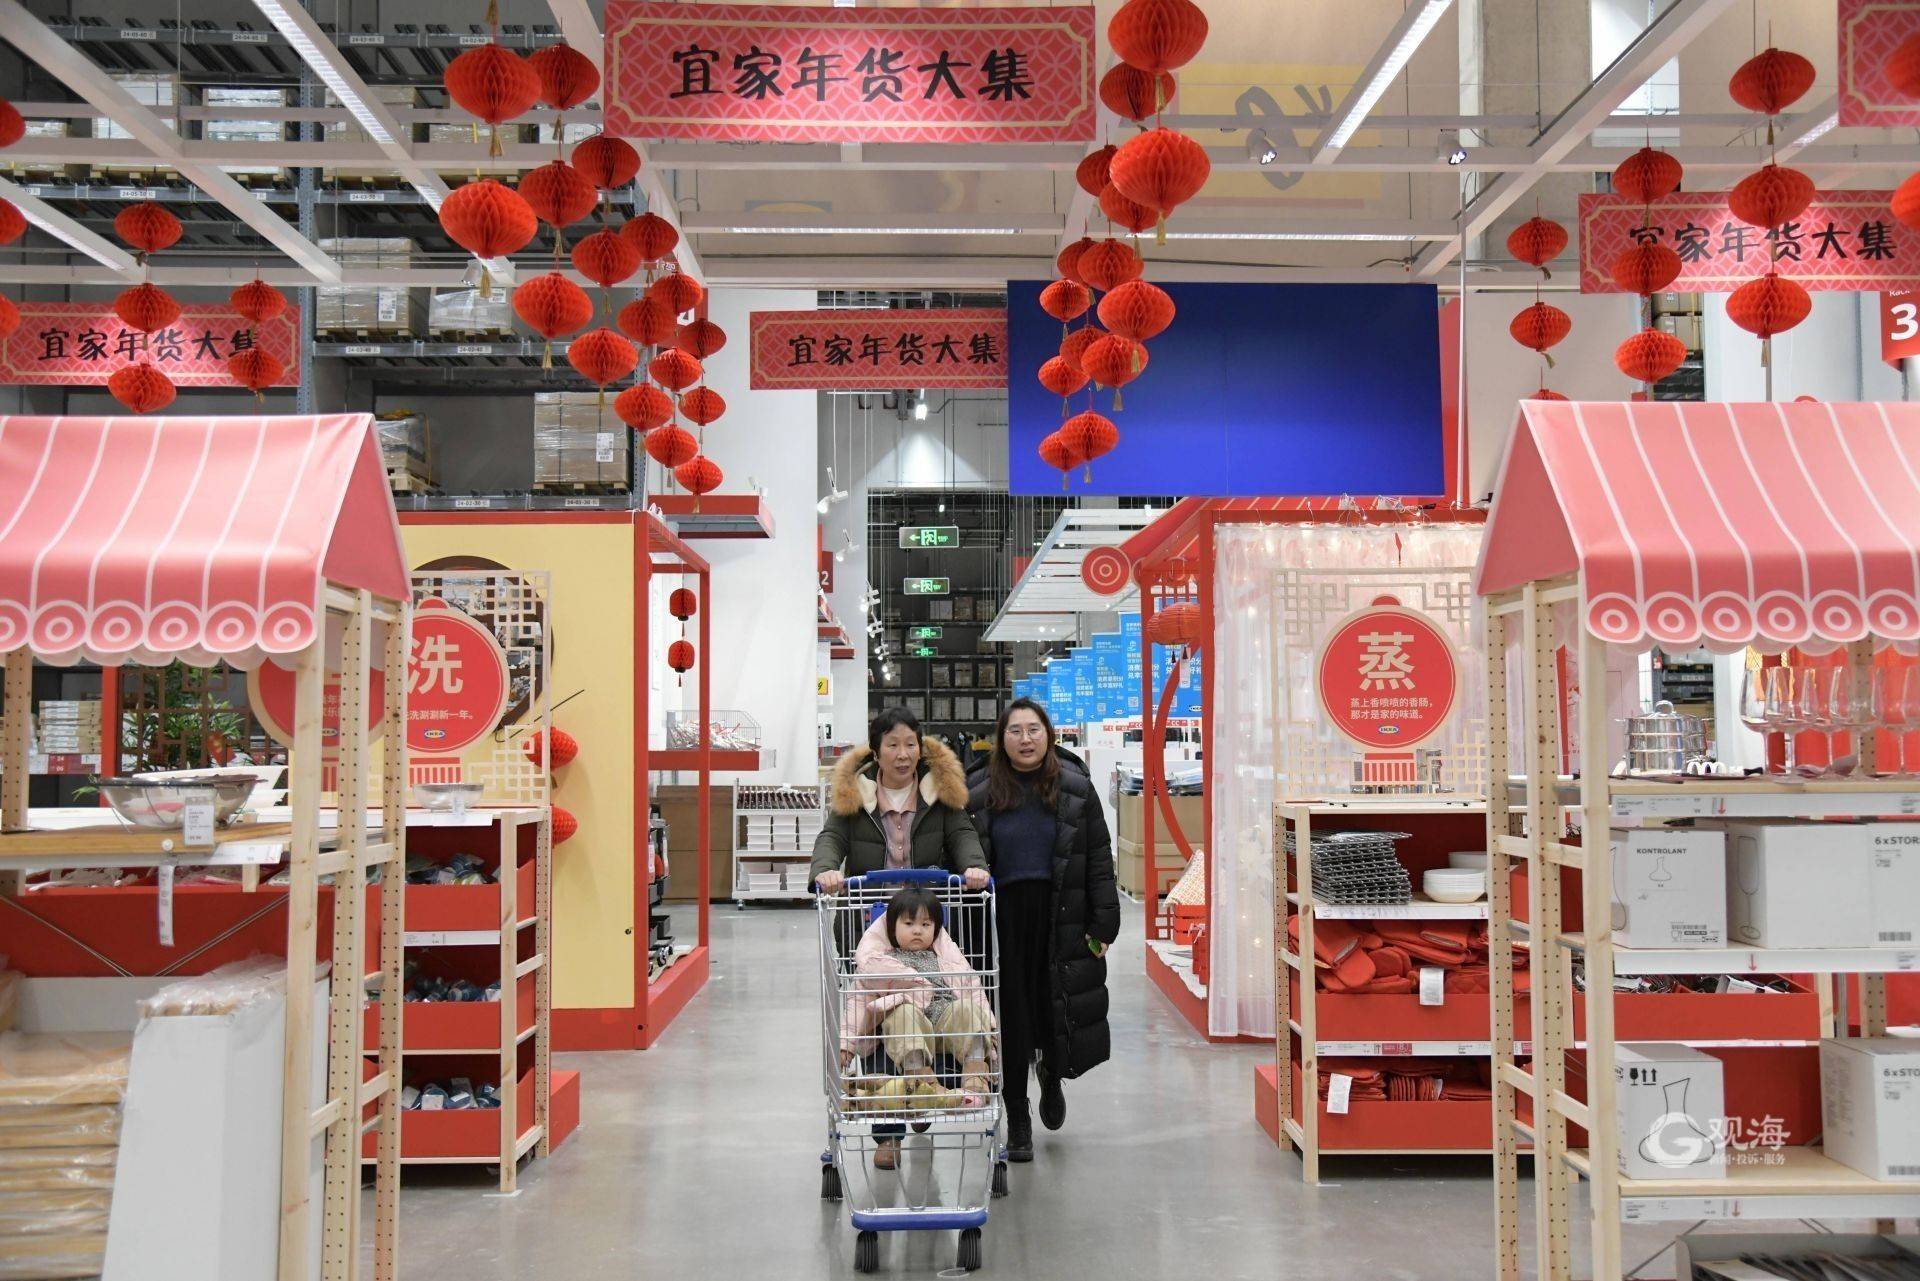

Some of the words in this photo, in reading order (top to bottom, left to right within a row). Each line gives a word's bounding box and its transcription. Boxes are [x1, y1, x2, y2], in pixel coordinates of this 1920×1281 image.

[670, 44, 1034, 102] 宜家年货大集
[1890, 303, 1919, 340] 3
[788, 333, 1000, 367] 宜家年货大集
[406, 634, 464, 694] 洗
[1358, 631, 1416, 691] 蒸
[1351, 709, 1424, 720] 那才是家的味道。
[425, 730, 445, 738] IKEA
[1379, 726, 1399, 734] IKEA
[1875, 836, 1882, 845] 6
[1890, 836, 1920, 845] STOR
[1884, 1069, 1891, 1077] 6
